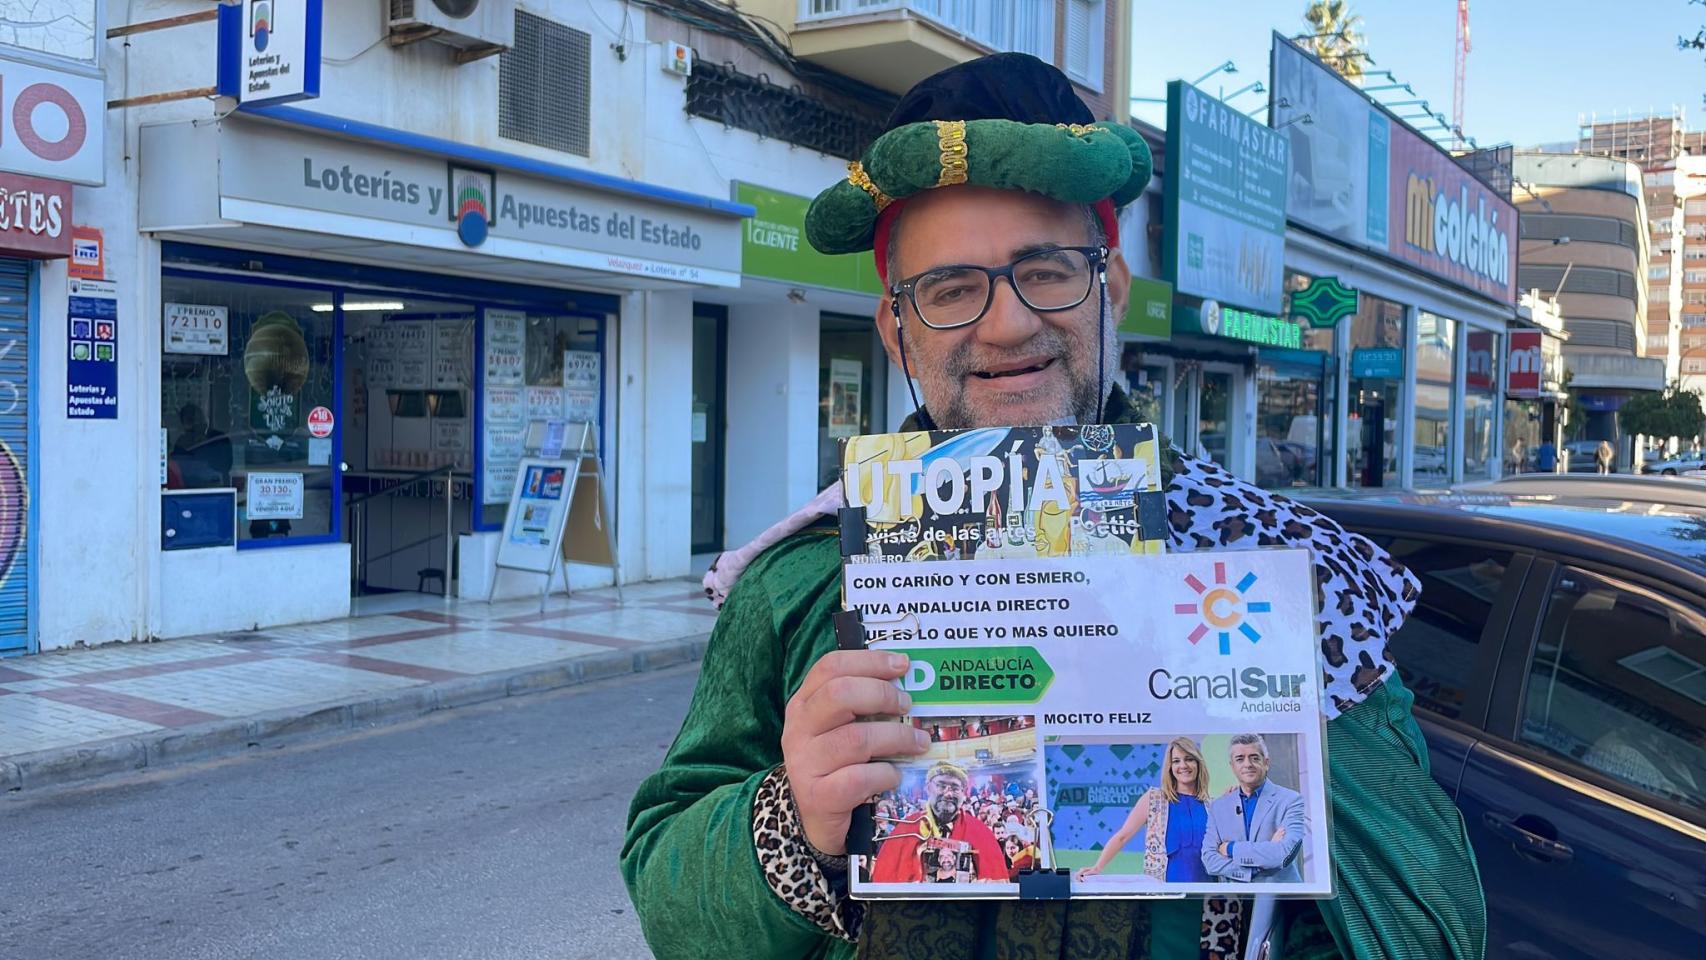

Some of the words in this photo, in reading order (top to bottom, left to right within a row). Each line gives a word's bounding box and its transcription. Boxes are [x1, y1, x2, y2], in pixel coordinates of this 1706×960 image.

[1199, 96, 1285, 166] FARMASTAR
[303, 157, 420, 204] Loterías
[428, 186, 442, 215] y
[500, 194, 601, 234] Apuestas
[606, 212, 635, 240] del
[641, 219, 702, 251] Estado
[753, 228, 799, 252] CLIENTE
[184, 307, 215, 317] PREMIO
[171, 315, 222, 330] 72110
[1222, 307, 1301, 349] FARMASTAR
[69, 407, 95, 416] Estado
[847, 440, 1071, 518] UTOPÍA
[866, 526, 918, 544] evista
[923, 526, 946, 541] de
[952, 525, 980, 541] las
[986, 524, 1037, 539] artes
[853, 576, 887, 589] CON
[892, 573, 954, 588] CARIÑO
[959, 574, 970, 586] Y
[975, 574, 1010, 586] CON
[1016, 571, 1091, 585] ESMERO,
[854, 603, 891, 615] VIVA
[896, 600, 992, 614] ANDALUCIA
[997, 598, 1070, 611] DIRECTO
[865, 629, 887, 641] UE
[893, 629, 913, 641] ES
[918, 628, 939, 640] LO
[944, 627, 978, 640] QUE
[984, 627, 1007, 638] YO
[1012, 626, 1048, 638] MAS
[1053, 624, 1119, 638] QUIERO
[939, 656, 1034, 672] ANDALUCÍA
[939, 673, 1036, 691] DIRECTO
[1044, 713, 1104, 724] MOCITO
[1109, 712, 1152, 724] FELIZ
[1088, 795, 1130, 804] DIRECTO
